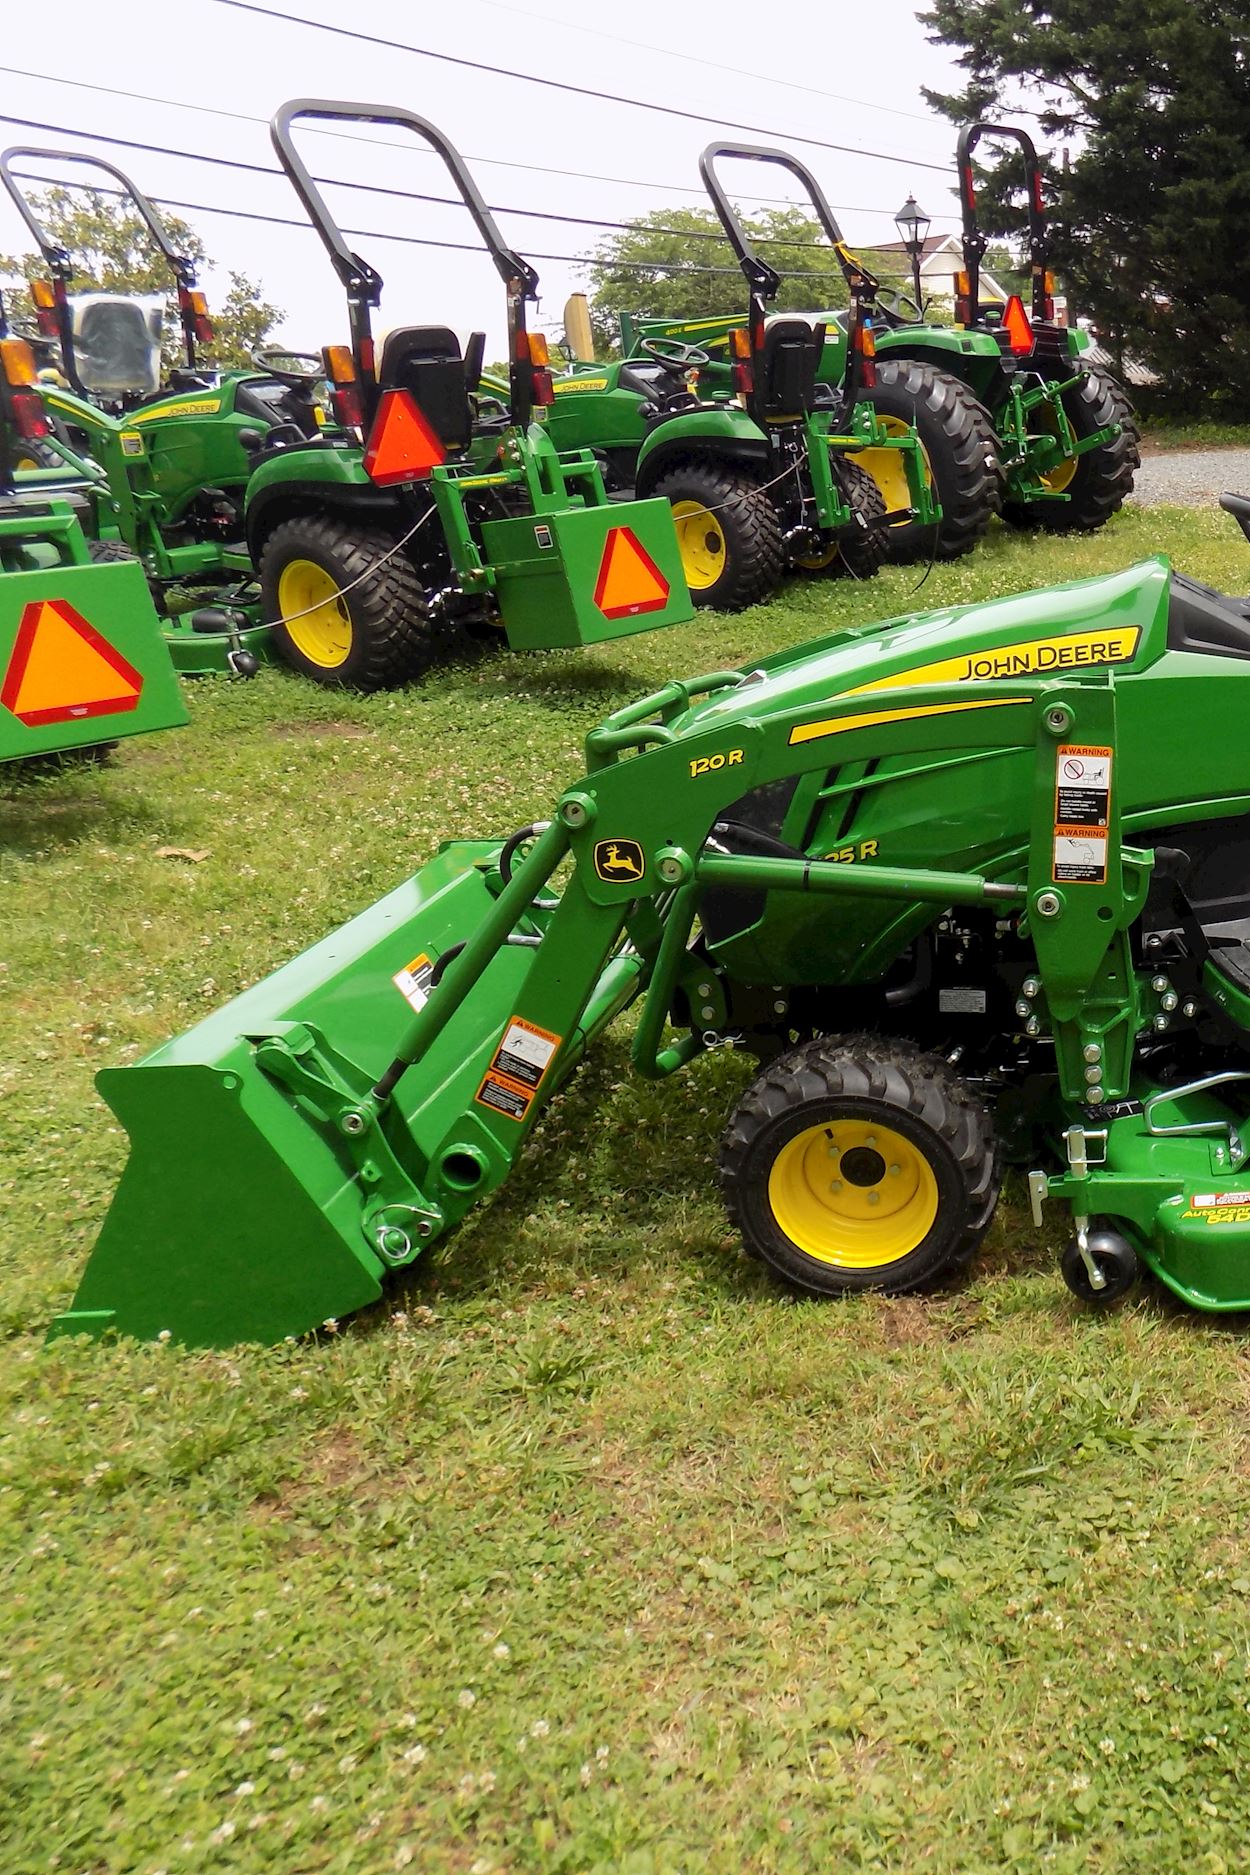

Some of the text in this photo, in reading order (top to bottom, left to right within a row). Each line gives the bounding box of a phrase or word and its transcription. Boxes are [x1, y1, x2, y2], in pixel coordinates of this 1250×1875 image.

[562, 382, 603, 392] JOHN DEERE
[168, 404, 215, 416] JOHN DEERE
[959, 640, 1123, 681] JOHN DEERE
[1068, 747, 1109, 756] WARNING
[689, 749, 744, 778] 120 R
[1066, 829, 1106, 838] WARNING
[860, 840, 878, 860] R
